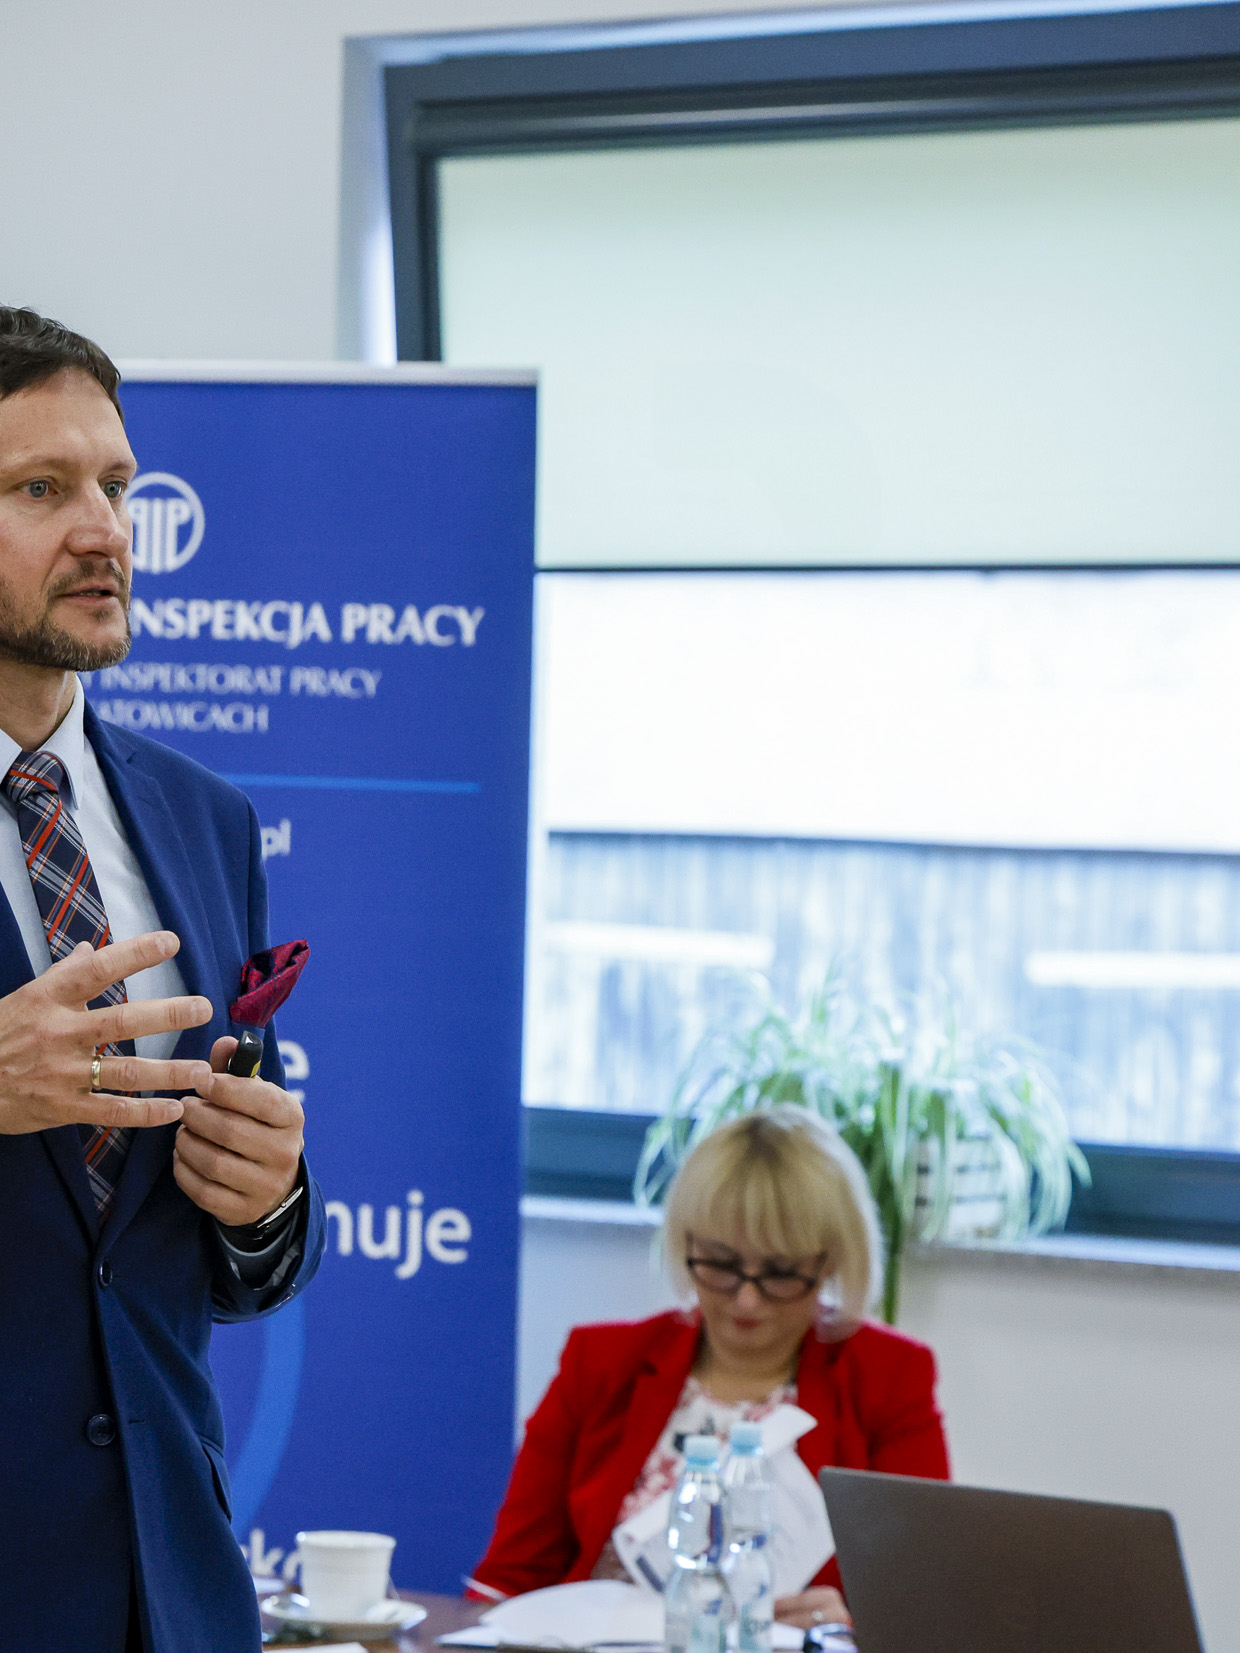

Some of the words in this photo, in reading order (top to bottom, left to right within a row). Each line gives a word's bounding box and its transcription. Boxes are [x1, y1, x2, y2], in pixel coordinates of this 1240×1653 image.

[129, 598, 334, 650] NSPEKCJA
[341, 603, 486, 648] PRACY
[98, 661, 285, 696] INSPEKTORAT
[289, 665, 383, 700] PRACY
